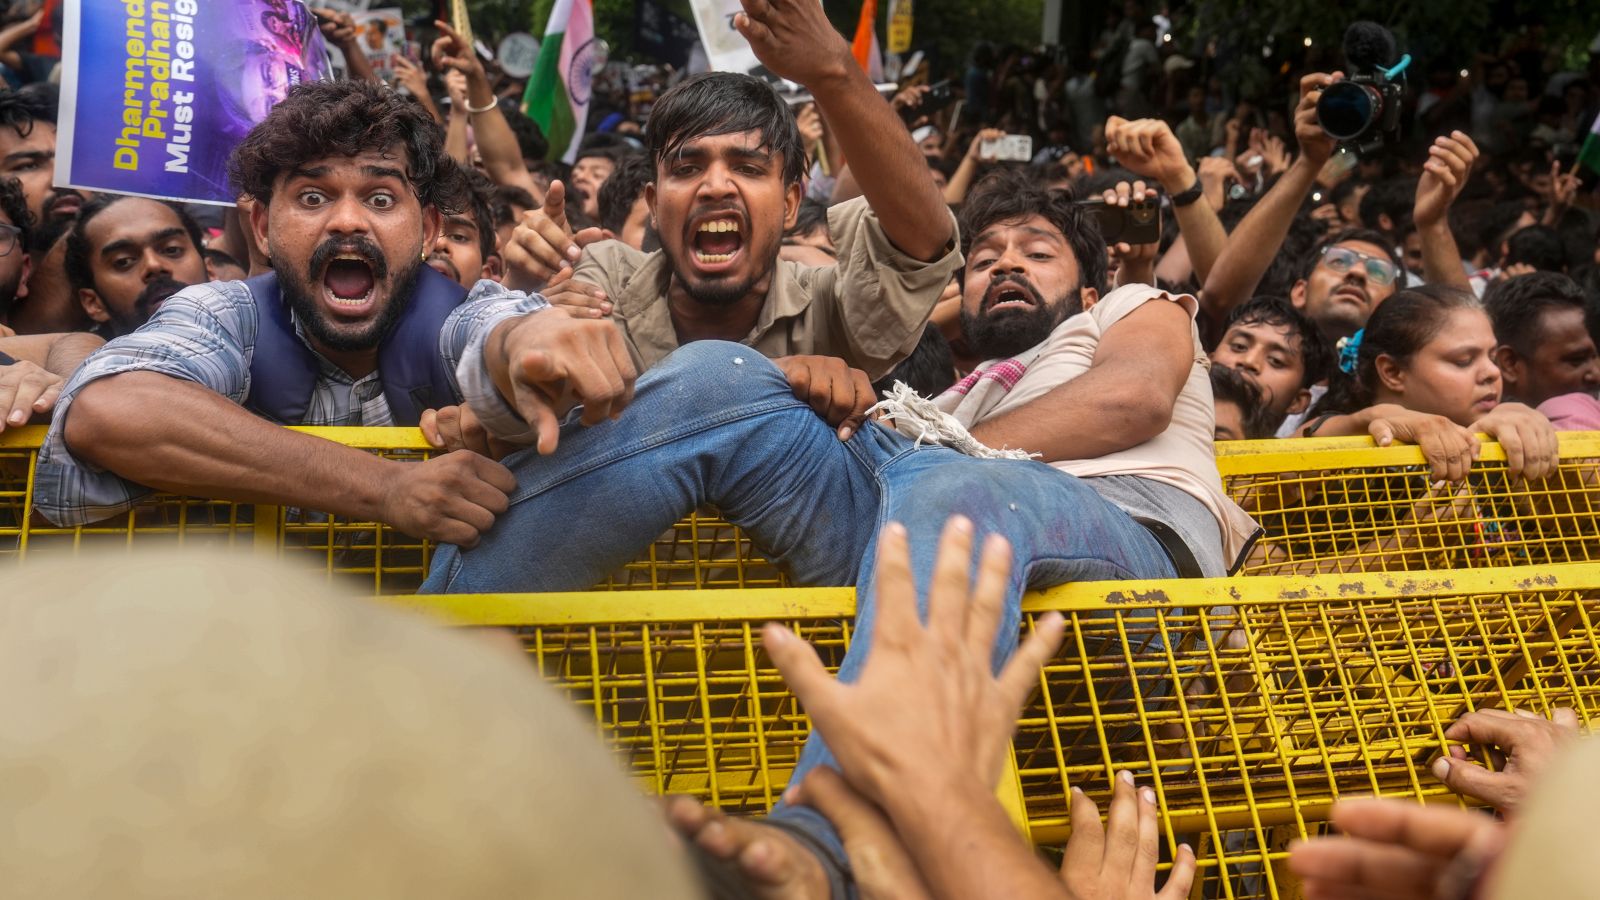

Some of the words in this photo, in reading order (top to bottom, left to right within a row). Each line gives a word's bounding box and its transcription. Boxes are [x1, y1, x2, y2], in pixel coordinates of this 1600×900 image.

[113, 0, 145, 171] Dharmend
[142, 1, 170, 139] Pradhan
[171, 0, 198, 82] Resig
[164, 90, 194, 174] Must
